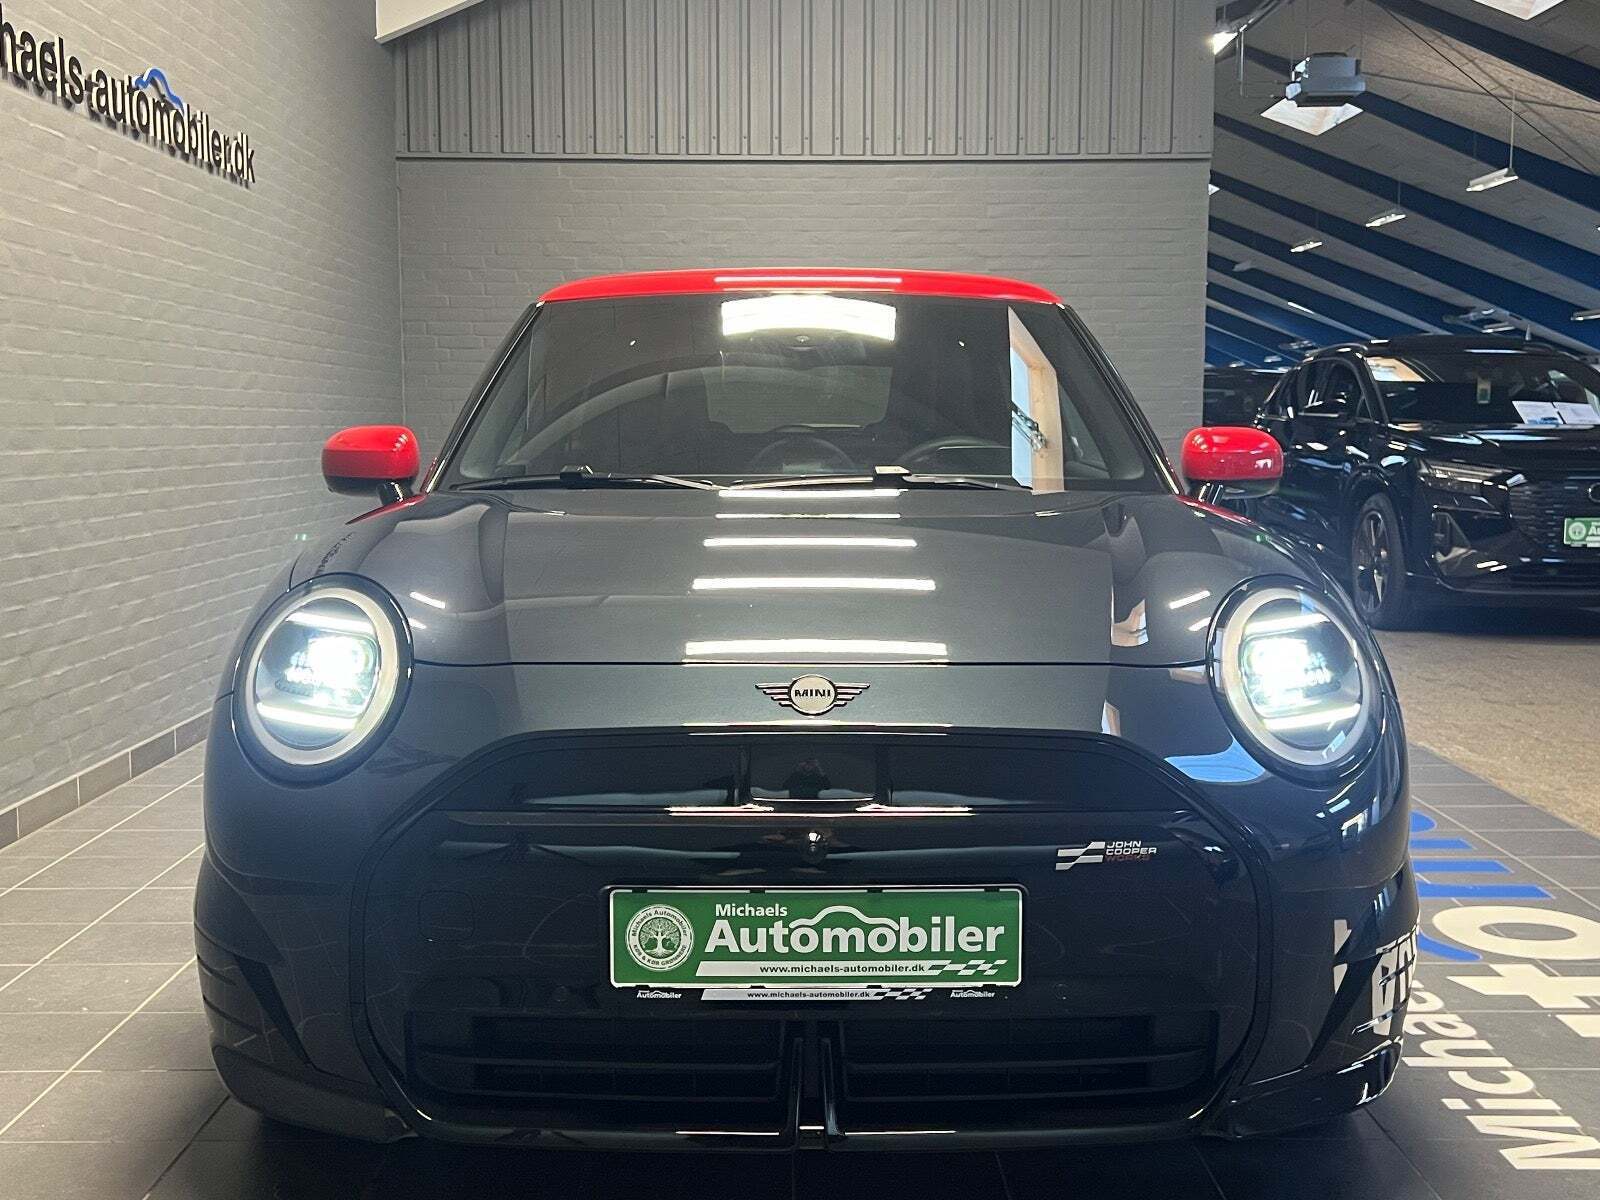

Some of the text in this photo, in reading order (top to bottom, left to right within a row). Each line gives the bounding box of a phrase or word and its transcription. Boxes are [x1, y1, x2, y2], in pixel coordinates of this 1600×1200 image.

[0, 2, 256, 184] haels-automobiler.dk
[794, 688, 832, 698] MINI
[1106, 840, 1142, 848] JOHN
[1105, 847, 1158, 856] COOPER
[715, 903, 788, 917] Michaels
[704, 915, 1005, 954] Automobiler
[759, 964, 925, 974] www.michaels-automobiler.dk
[636, 990, 682, 999] Automobiler
[747, 991, 871, 999] www.michaels-automobiler.dk
[950, 990, 996, 998] Automobiler
